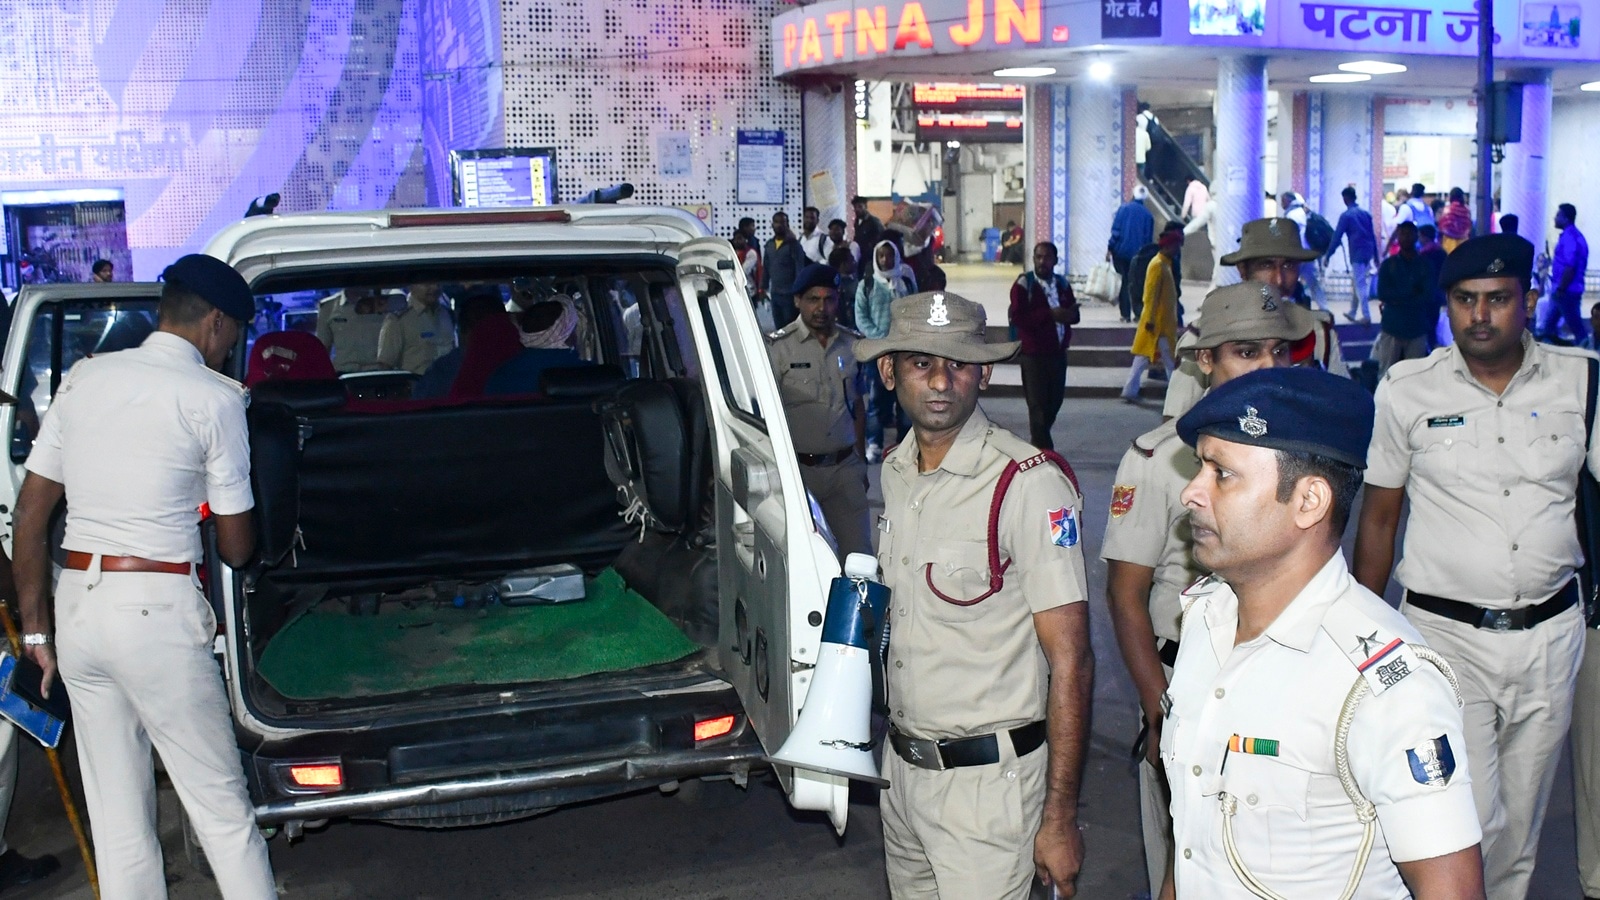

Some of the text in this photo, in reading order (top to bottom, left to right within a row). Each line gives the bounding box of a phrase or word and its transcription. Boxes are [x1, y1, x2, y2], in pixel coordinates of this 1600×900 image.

[1105, 0, 1125, 18] गेट
[1148, 1, 1158, 17] 4
[783, 0, 1069, 68] PATNA JN.
[1300, 3, 1432, 42] पटना
[1019, 453, 1047, 471] RPSF
[1375, 654, 1408, 679] बिहार
[1379, 665, 1412, 691] पुलिस
